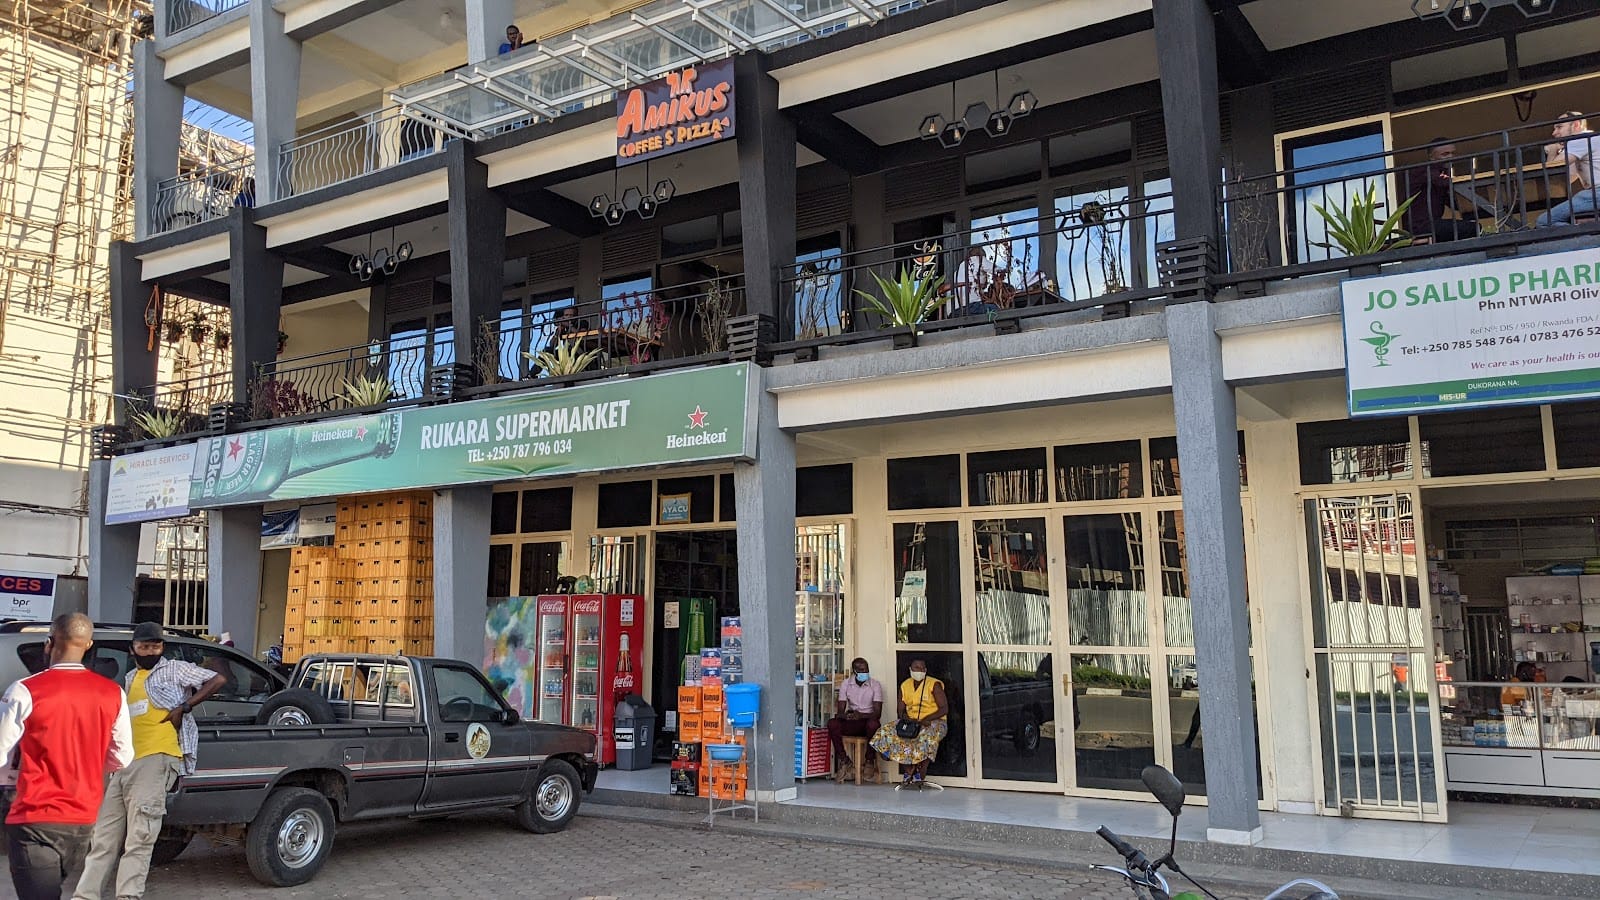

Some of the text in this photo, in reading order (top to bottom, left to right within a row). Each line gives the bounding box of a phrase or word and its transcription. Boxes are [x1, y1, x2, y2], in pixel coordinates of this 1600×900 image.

[619, 135, 663, 158] COFFEE
[677, 118, 723, 143] PIZZA
[1363, 262, 1600, 312] JO SALUD PHAR
[1478, 299, 1505, 311] Phn
[1509, 291, 1566, 308] NTWARI
[1542, 316, 1574, 327] Rwanda
[1576, 314, 1594, 324] FDA
[1400, 344, 1420, 355] Tel:
[1422, 341, 1449, 353] +250
[1452, 339, 1472, 350] 785
[1475, 337, 1496, 348] 548
[1499, 334, 1520, 345] 764
[1522, 333, 1528, 343] /
[1529, 330, 1559, 342] 0783
[1562, 328, 1584, 339] 476
[1471, 361, 1486, 370] We
[1487, 359, 1508, 368] care
[1509, 358, 1519, 367] as
[1522, 356, 1544, 367] your
[1545, 351, 1575, 363] health
[1577, 351, 1586, 360] is
[1467, 379, 1520, 390] DUKORANA NA:
[420, 417, 490, 450] RUKARA
[495, 399, 631, 441] SUPERMARKET
[311, 426, 353, 443] Heineken
[666, 430, 727, 449] Heineken
[241, 442, 258, 476] LAGER
[467, 438, 572, 463] TEL: +250 787 796 034
[1, 576, 42, 592] CES
[12, 596, 31, 608] bpr
